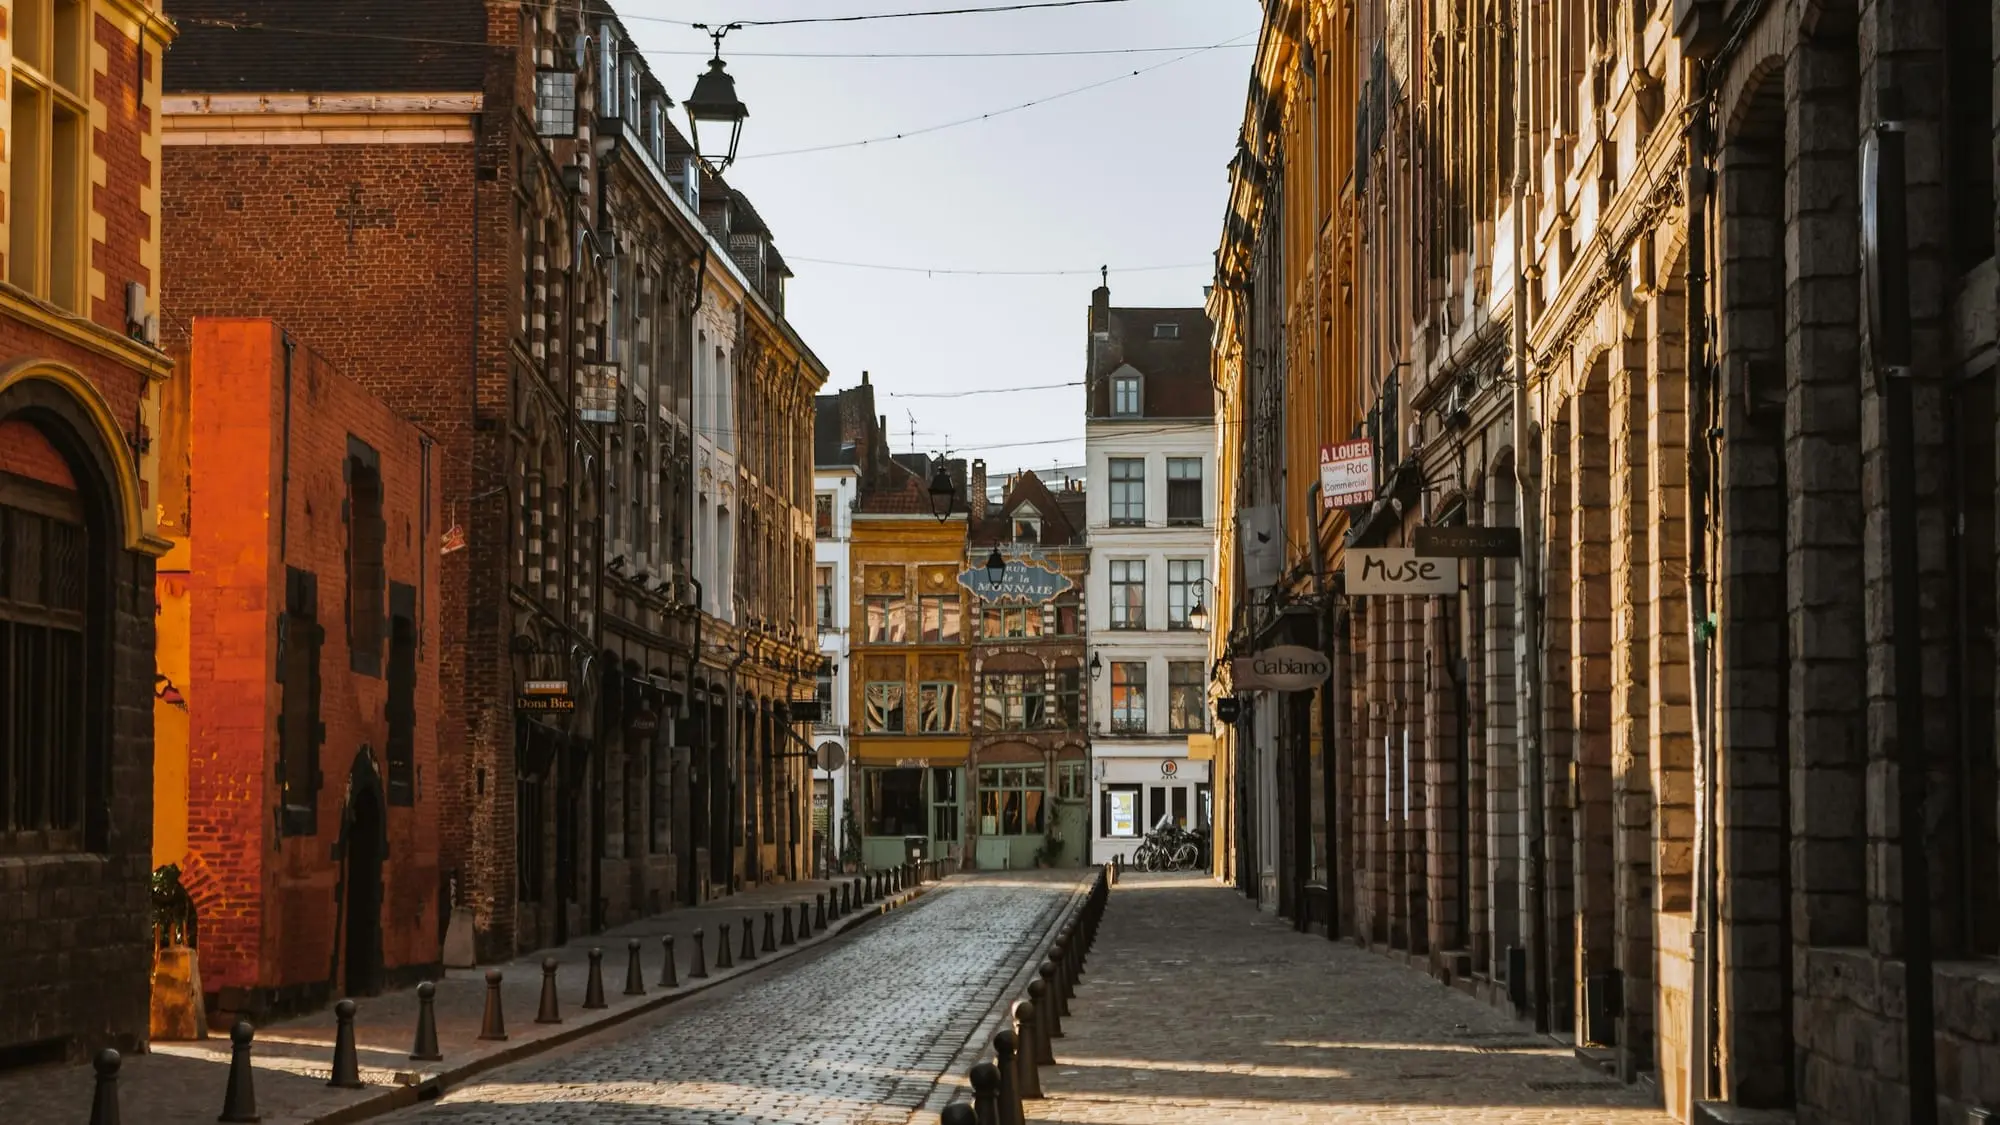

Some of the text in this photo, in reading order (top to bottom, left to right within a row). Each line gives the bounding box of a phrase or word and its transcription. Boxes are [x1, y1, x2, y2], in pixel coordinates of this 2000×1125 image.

[1321, 442, 1369, 462] A LOUER
[1346, 462, 1368, 476] Rdc
[1325, 478, 1367, 493] Commercial
[1353, 492, 1362, 503] 52
[1363, 491, 1373, 502] 10
[1361, 554, 1442, 582] Muse
[1019, 574, 1030, 583] la
[977, 581, 1053, 595] MONNAIE
[1253, 658, 1327, 675] Gabiano
[517, 697, 574, 709] Dona Bica
